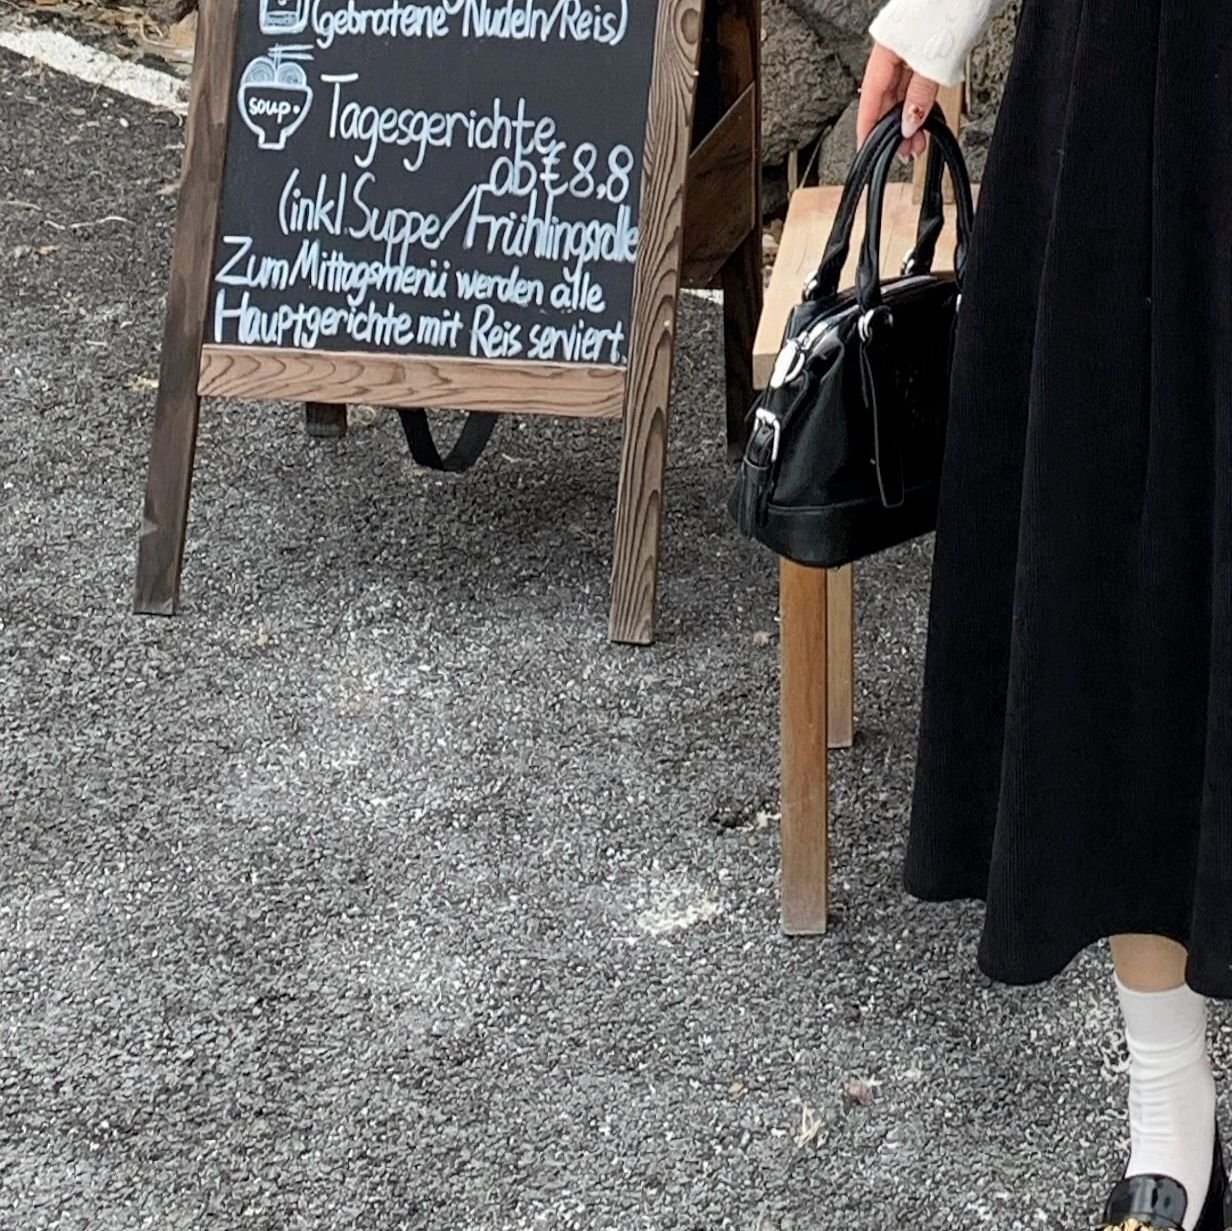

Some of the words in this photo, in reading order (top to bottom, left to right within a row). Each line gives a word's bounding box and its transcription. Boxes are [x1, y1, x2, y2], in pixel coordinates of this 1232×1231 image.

[320, 72, 557, 172] Tagesgerichte
[215, 235, 289, 290] Zum
[289, 238, 448, 307] Mittagsmenü
[454, 265, 544, 307] werden
[550, 269, 606, 313] alle
[213, 288, 415, 349] Hauptgerichte
[417, 309, 463, 348] mit
[469, 303, 523, 358] Reis
